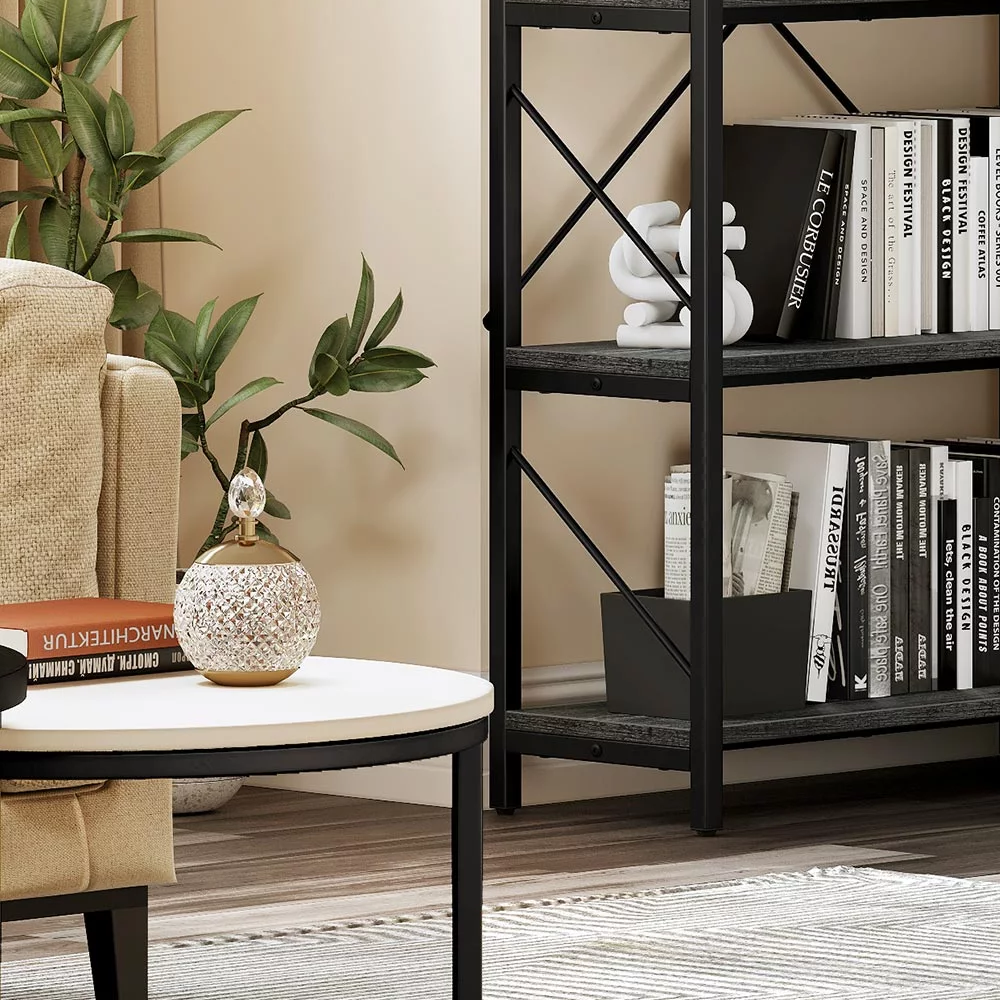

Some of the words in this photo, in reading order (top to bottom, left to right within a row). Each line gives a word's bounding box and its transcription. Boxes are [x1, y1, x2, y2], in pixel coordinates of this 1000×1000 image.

[904, 131, 912, 177] DESIGN
[958, 128, 967, 174] DESIGN
[817, 168, 834, 196] LE
[904, 183, 912, 238] FESTIVAL
[942, 178, 951, 221] BLACK
[958, 180, 967, 235] FESTIVAL
[787, 198, 826, 309] CORBUSIER
[942, 230, 951, 279] DESIGN
[668, 507, 690, 525] anxie
[945, 539, 955, 567] lets,
[961, 524, 971, 570] BLACK
[978, 546, 988, 574] BOOK
[945, 571, 955, 604] clean
[978, 578, 988, 612] ABOUT
[945, 608, 955, 630] the
[961, 579, 971, 631] DESIGN
[43, 623, 176, 651] NARCHITEKTUR
[945, 634, 955, 651] air
[978, 616, 988, 653] POINTS
[28, 660, 75, 682] СНИМАЙ!
[76, 654, 115, 677] ДУМАЙ.
[117, 651, 160, 671] СМОТРИ.
